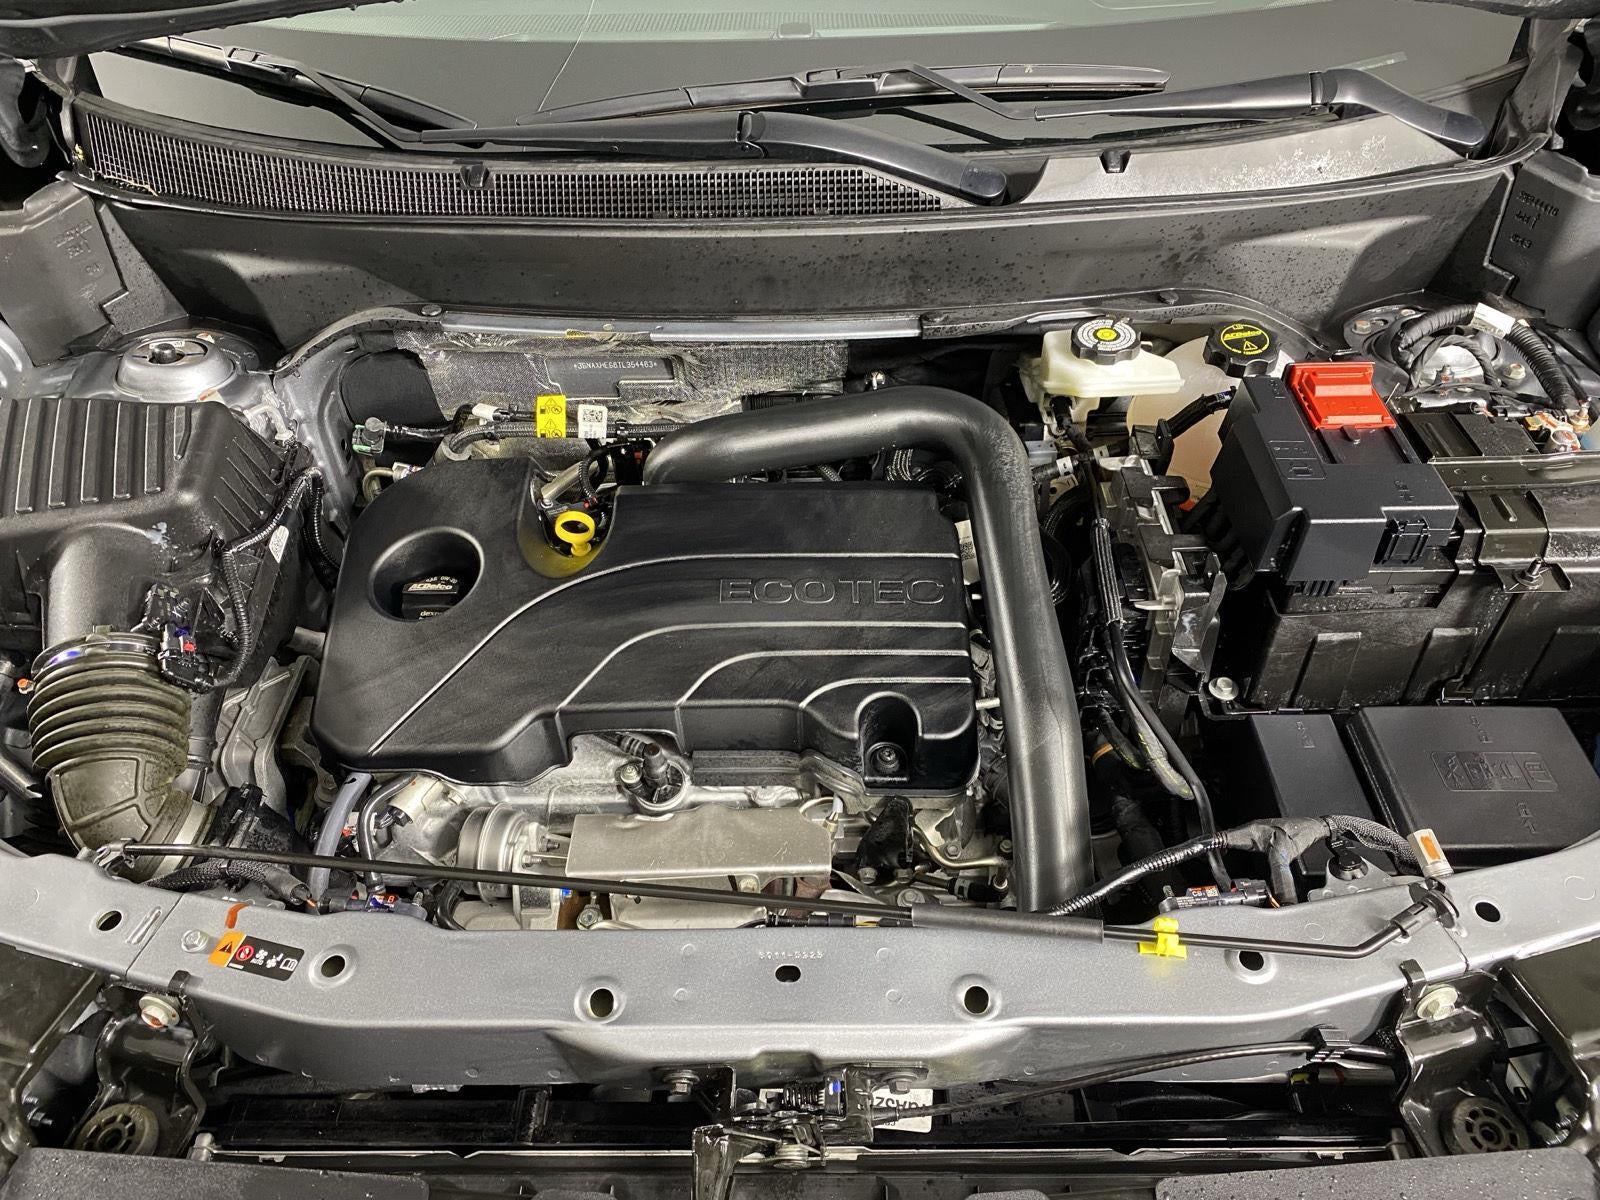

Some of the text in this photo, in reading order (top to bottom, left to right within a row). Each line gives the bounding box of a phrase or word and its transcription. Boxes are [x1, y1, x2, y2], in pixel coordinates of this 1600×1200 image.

[408, 583, 453, 591] ACDelco
[719, 578, 945, 604] ECOTEC
[250, 957, 265, 966] AUTO
